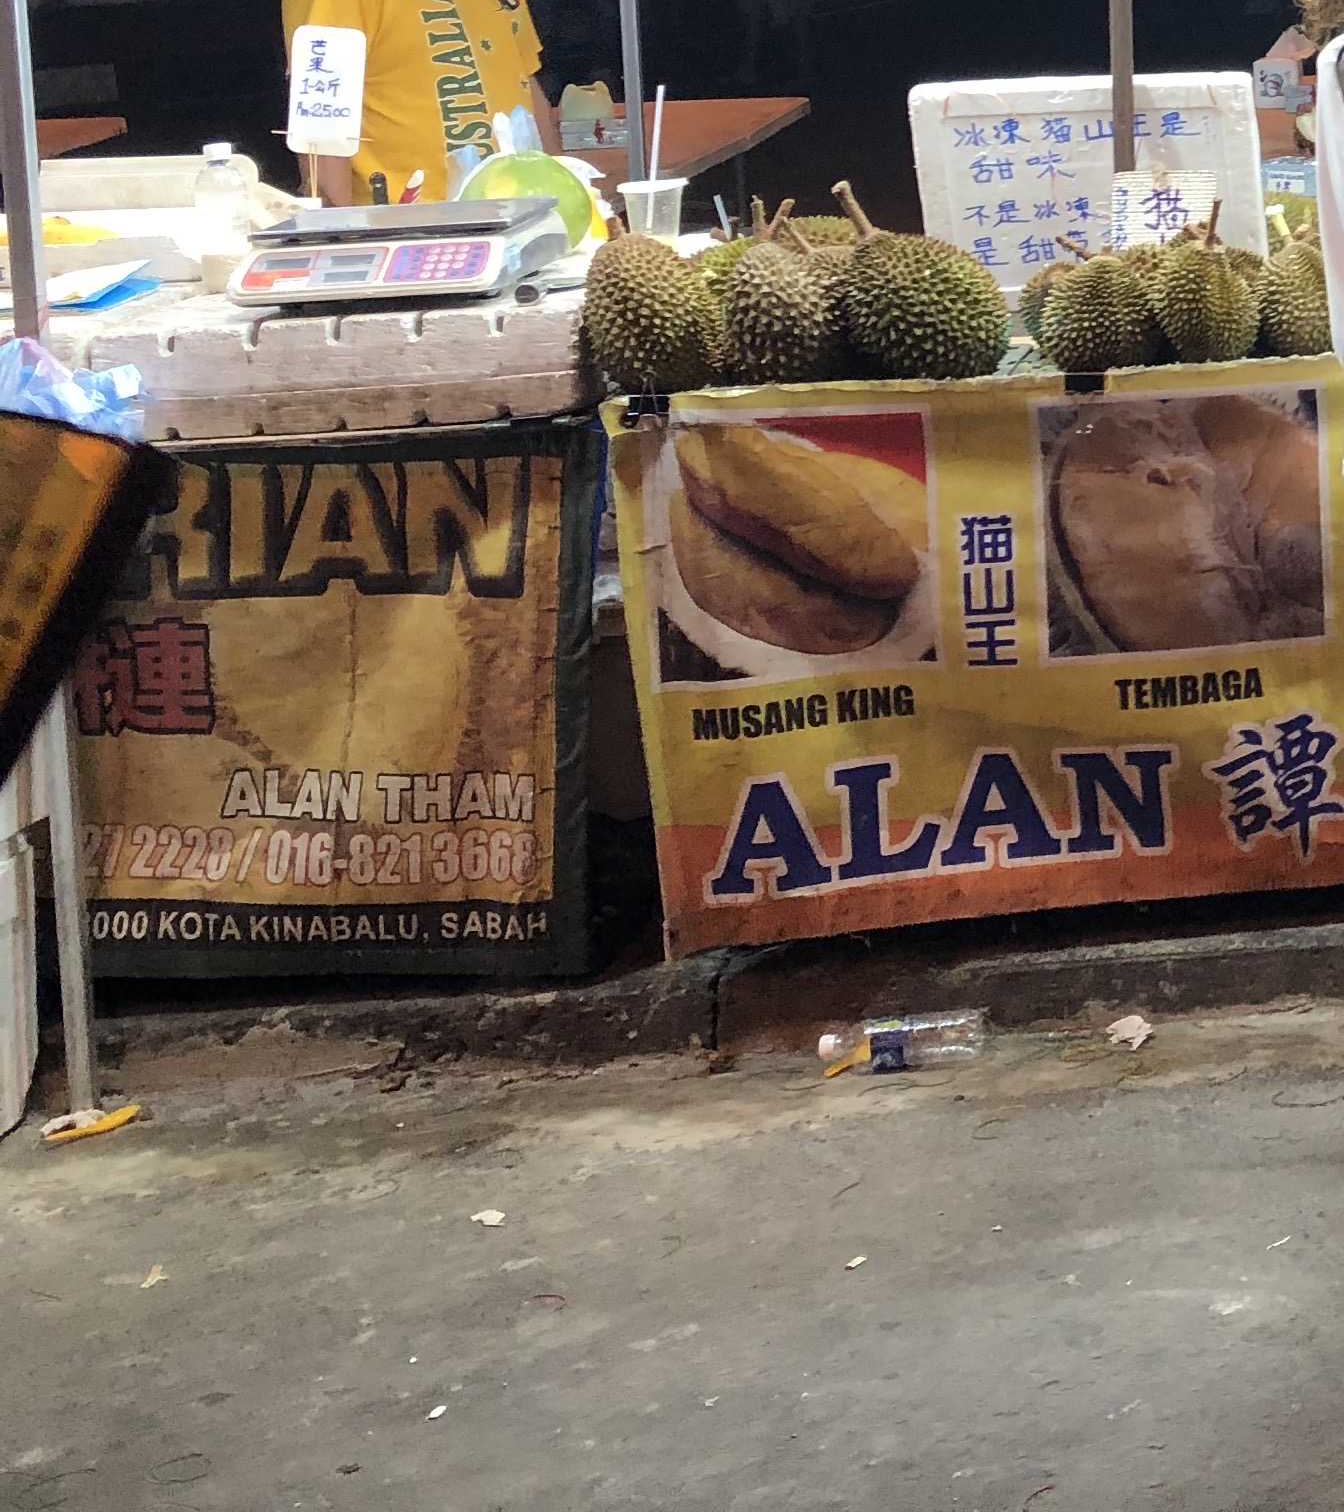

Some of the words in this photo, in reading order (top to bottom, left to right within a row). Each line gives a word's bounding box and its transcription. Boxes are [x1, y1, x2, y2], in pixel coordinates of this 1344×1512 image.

[960, 514, 1019, 668] 猫山王
[692, 691, 829, 742] MUSANG
[836, 684, 915, 724] KING
[1114, 667, 1264, 711] TEMBAGA
[222, 768, 364, 824] ALAN
[376, 770, 537, 824] THAM
[706, 750, 1177, 899] ALAN
[129, 823, 236, 882] 2228
[265, 828, 422, 887] 016-821
[90, 909, 149, 941] 000
[156, 909, 242, 943] KOTA
[249, 912, 430, 946] KINABALU,
[439, 909, 548, 944] SABAH
